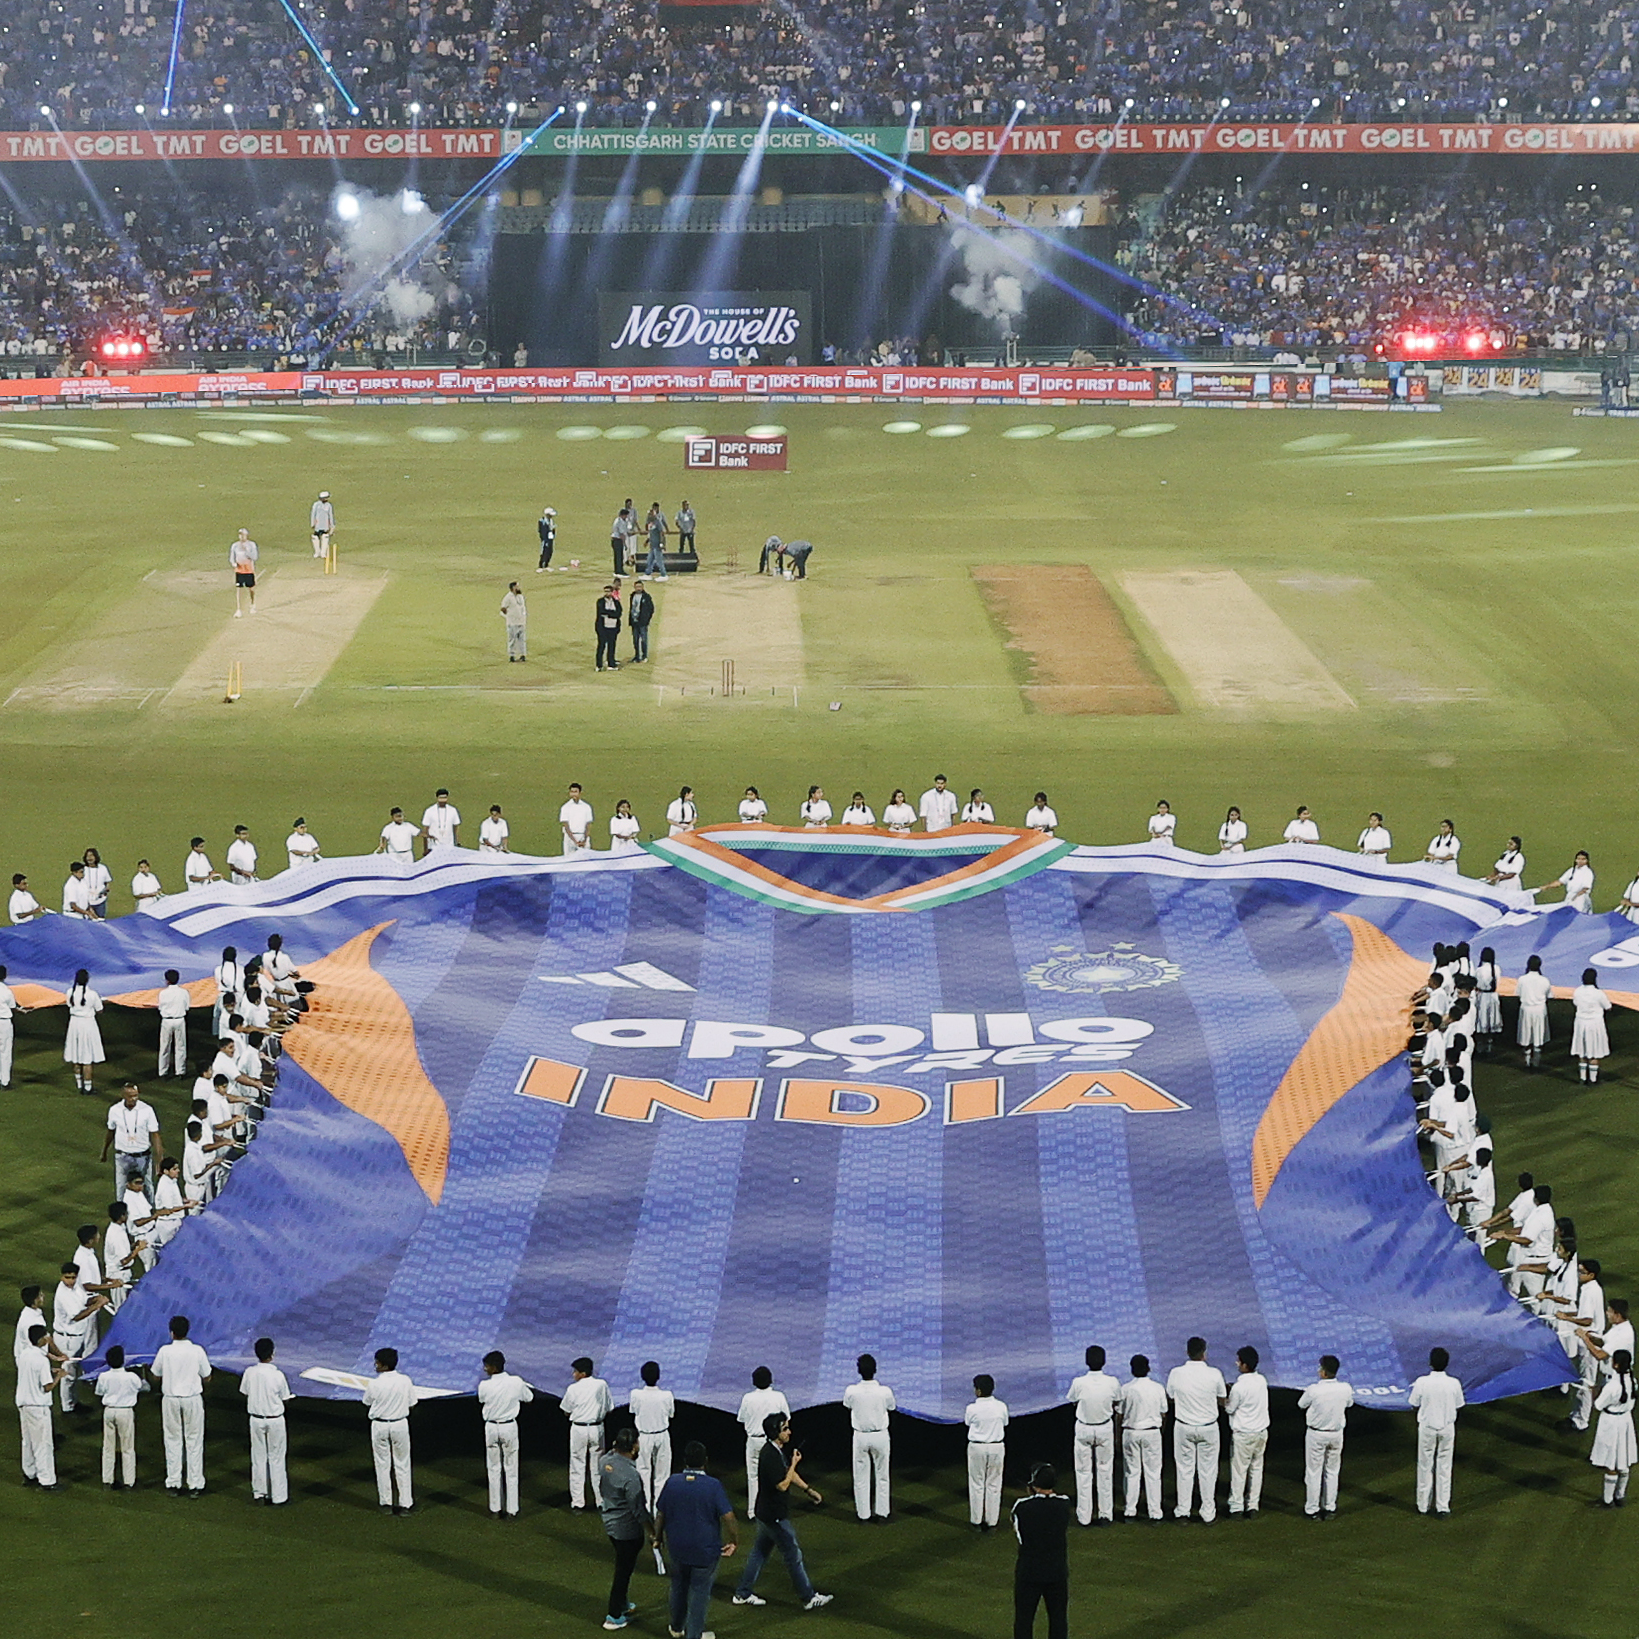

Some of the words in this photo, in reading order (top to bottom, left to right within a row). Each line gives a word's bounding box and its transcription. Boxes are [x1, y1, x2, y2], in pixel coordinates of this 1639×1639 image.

[7, 136, 60, 156] TMT
[74, 135, 143, 156] GOEL
[153, 135, 207, 155] TMT
[219, 135, 288, 155] GOEL
[297, 134, 351, 155] TMT
[364, 134, 433, 154] GOEL
[443, 133, 495, 154] TMT
[554, 134, 683, 150] CHHATTISGARH
[688, 134, 745, 149] STATE
[751, 133, 814, 149] CRICKET
[818, 133, 879, 148] SANGH
[932, 130, 1001, 151] GOEL
[1010, 130, 1062, 150] TMT
[1075, 129, 1143, 149] GOEL
[1152, 129, 1206, 149] TMT
[1216, 128, 1285, 149] GOEL
[1294, 128, 1347, 148] TMT
[1361, 128, 1430, 149] GOEL
[1439, 128, 1493, 150] TMT
[1504, 128, 1574, 150] GOEL
[1582, 128, 1635, 150] TMT
[703, 308, 719, 316] THE
[722, 308, 751, 316] HOUSE
[611, 304, 800, 350] McDowell's
[61, 379, 81, 388] AIR
[82, 378, 111, 388] INDIA
[198, 376, 218, 385] AIR
[219, 375, 248, 385] INDIA
[769, 375, 800, 388] IDFC
[803, 375, 841, 388] FIRST
[844, 375, 877, 388] Bank
[905, 376, 936, 390] IDFC
[940, 377, 978, 390] FIRST
[980, 377, 1014, 390] Bank
[1042, 377, 1073, 391] IDFC
[1076, 378, 1114, 391] FIRST
[1118, 378, 1152, 391] Bank
[1444, 372, 1462, 385] 24
[1468, 373, 1489, 388] 24
[1495, 372, 1513, 386] 24
[1519, 373, 1541, 389] 24
[571, 1013, 1155, 1059] apollo
[766, 1043, 1143, 1073] TYRES
[514, 1056, 1193, 1127] INDIA
